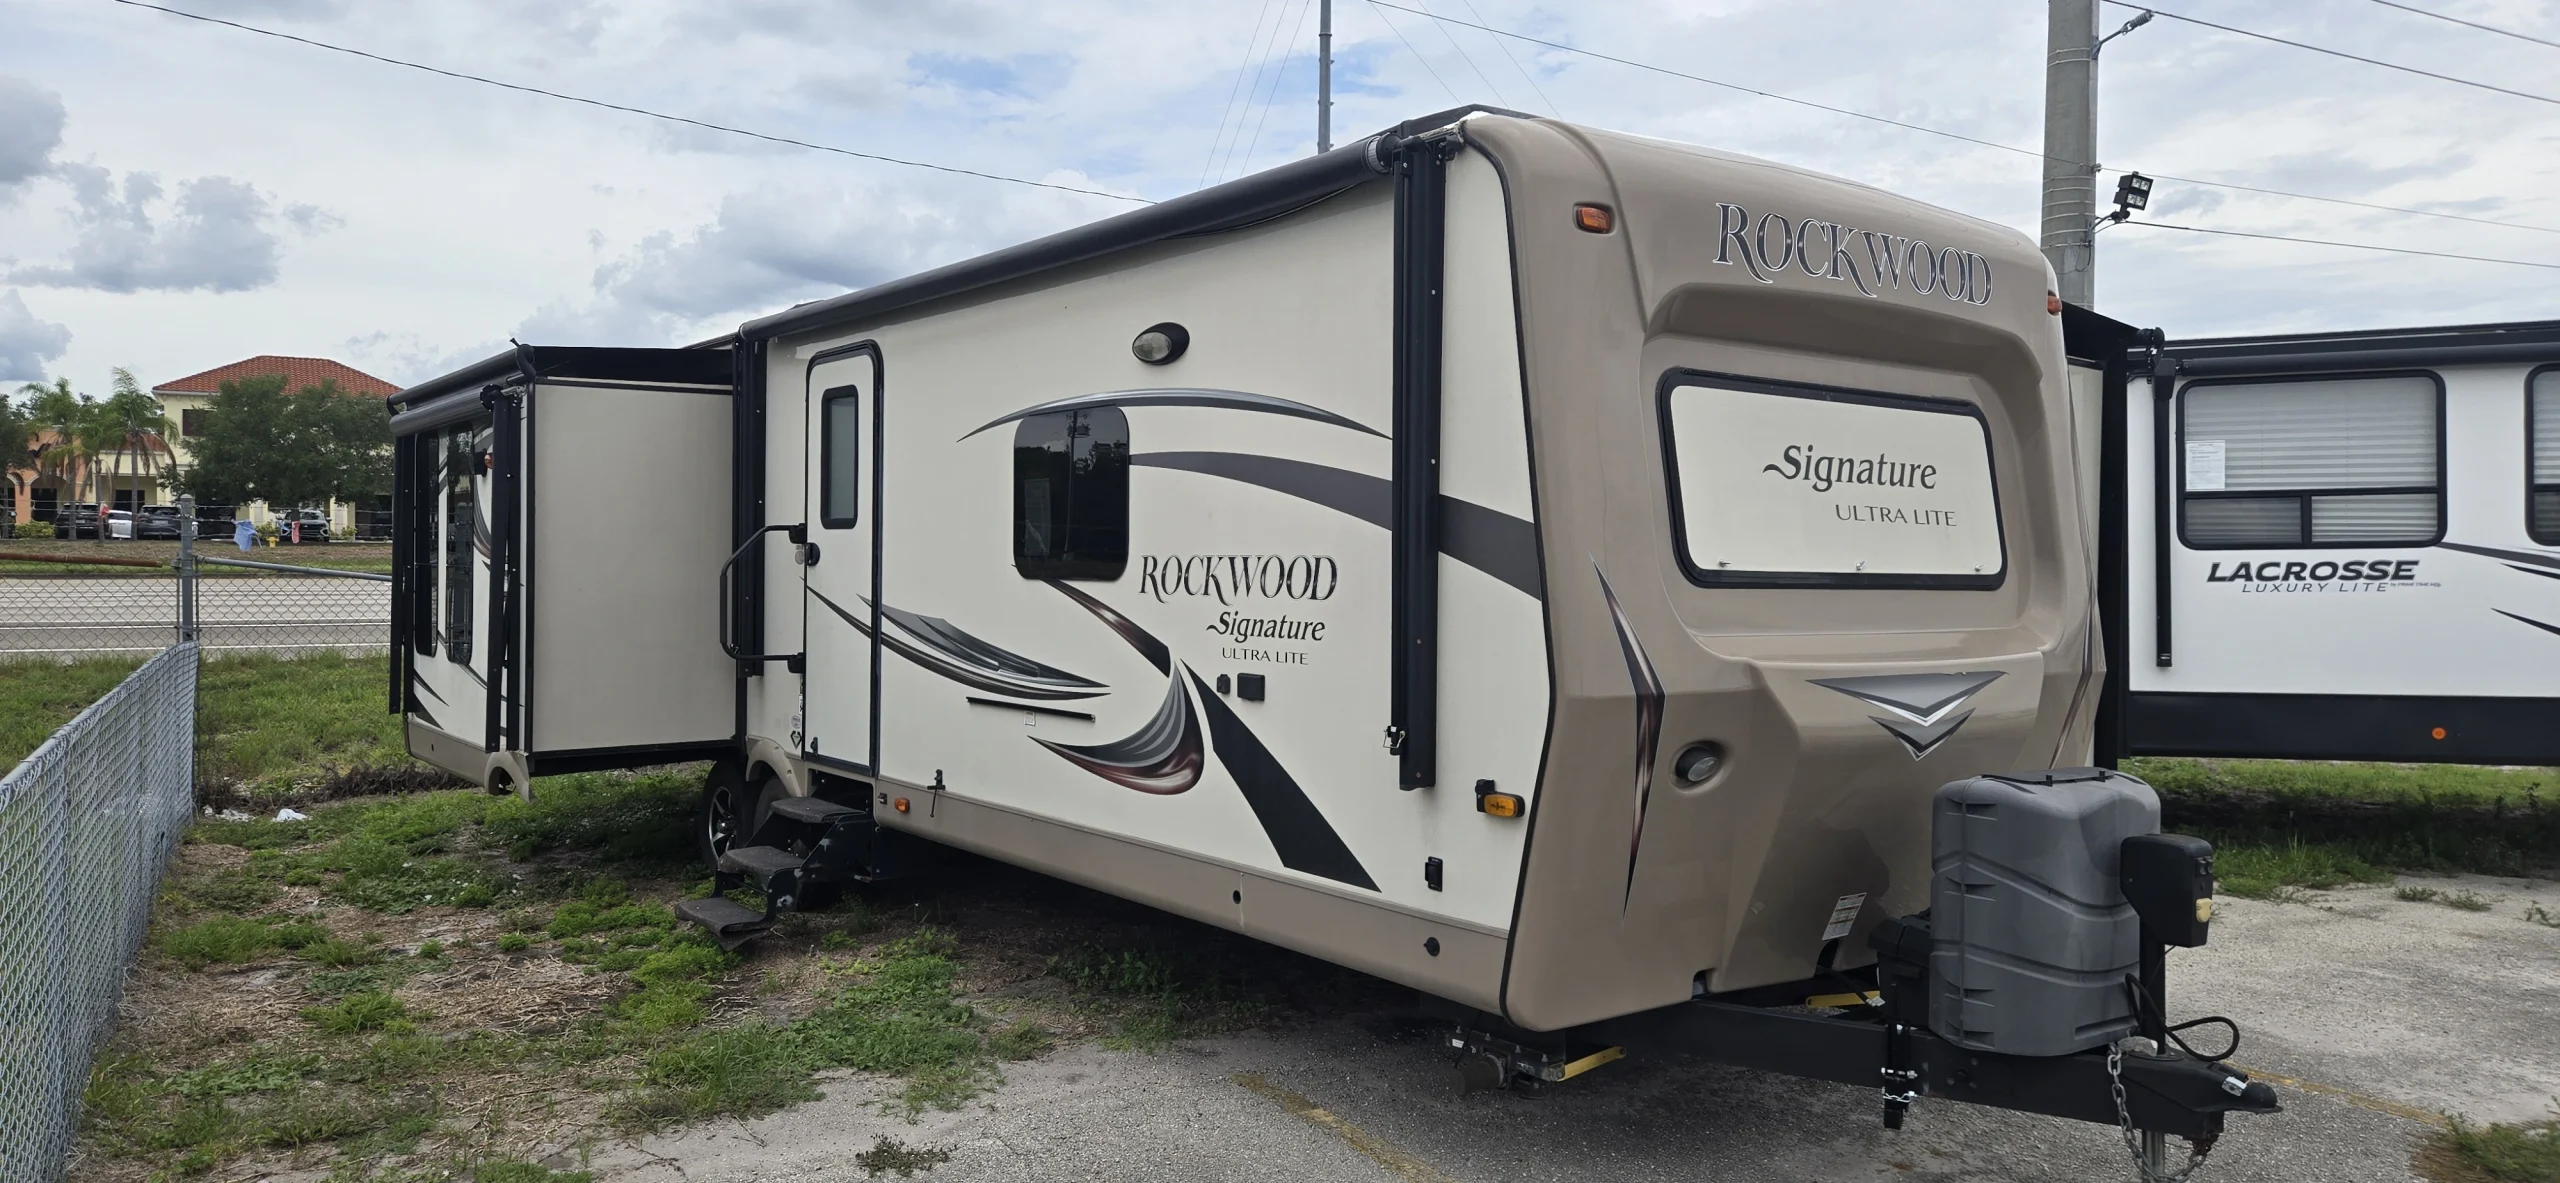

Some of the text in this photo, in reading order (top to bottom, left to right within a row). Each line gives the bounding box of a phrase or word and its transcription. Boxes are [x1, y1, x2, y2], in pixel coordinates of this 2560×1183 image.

[1713, 202, 1993, 306] ROCKWOOD
[1762, 444, 1937, 493] Signature
[1835, 504, 1957, 527] ULTRA LITE
[1138, 554, 1338, 607] ROCKWOOD
[2206, 559, 2420, 582] LACROSSE
[2241, 582, 2389, 593] LUXURY LITE
[1206, 610, 1326, 643] Signature
[1221, 646, 1309, 665] ULTRA LITE
